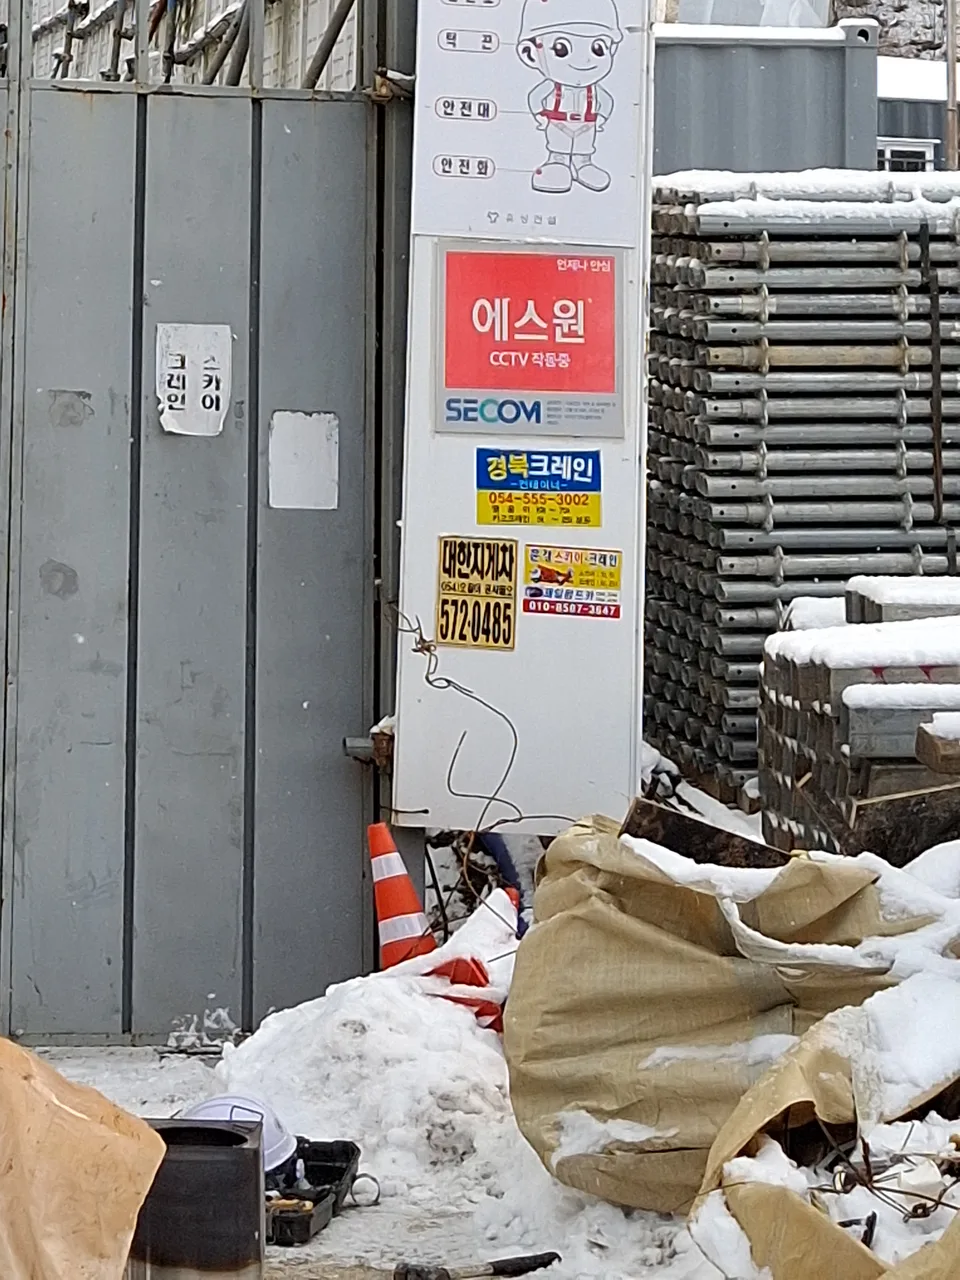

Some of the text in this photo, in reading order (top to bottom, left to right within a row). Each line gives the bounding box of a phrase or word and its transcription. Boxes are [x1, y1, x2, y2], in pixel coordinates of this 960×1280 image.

[442, 99, 491, 118] 안전대
[440, 158, 489, 176] 안전화
[556, 259, 611, 272] 언제나 안심
[472, 297, 586, 344] 에스원
[489, 351, 571, 368] CCTV 작동중
[166, 352, 187, 411] 크레인
[201, 355, 222, 412] 스카이
[445, 398, 542, 424] SECOM
[486, 452, 593, 483] 경북크레인
[489, 492, 589, 506] 054-555-3002
[442, 540, 514, 582] 대한지게차
